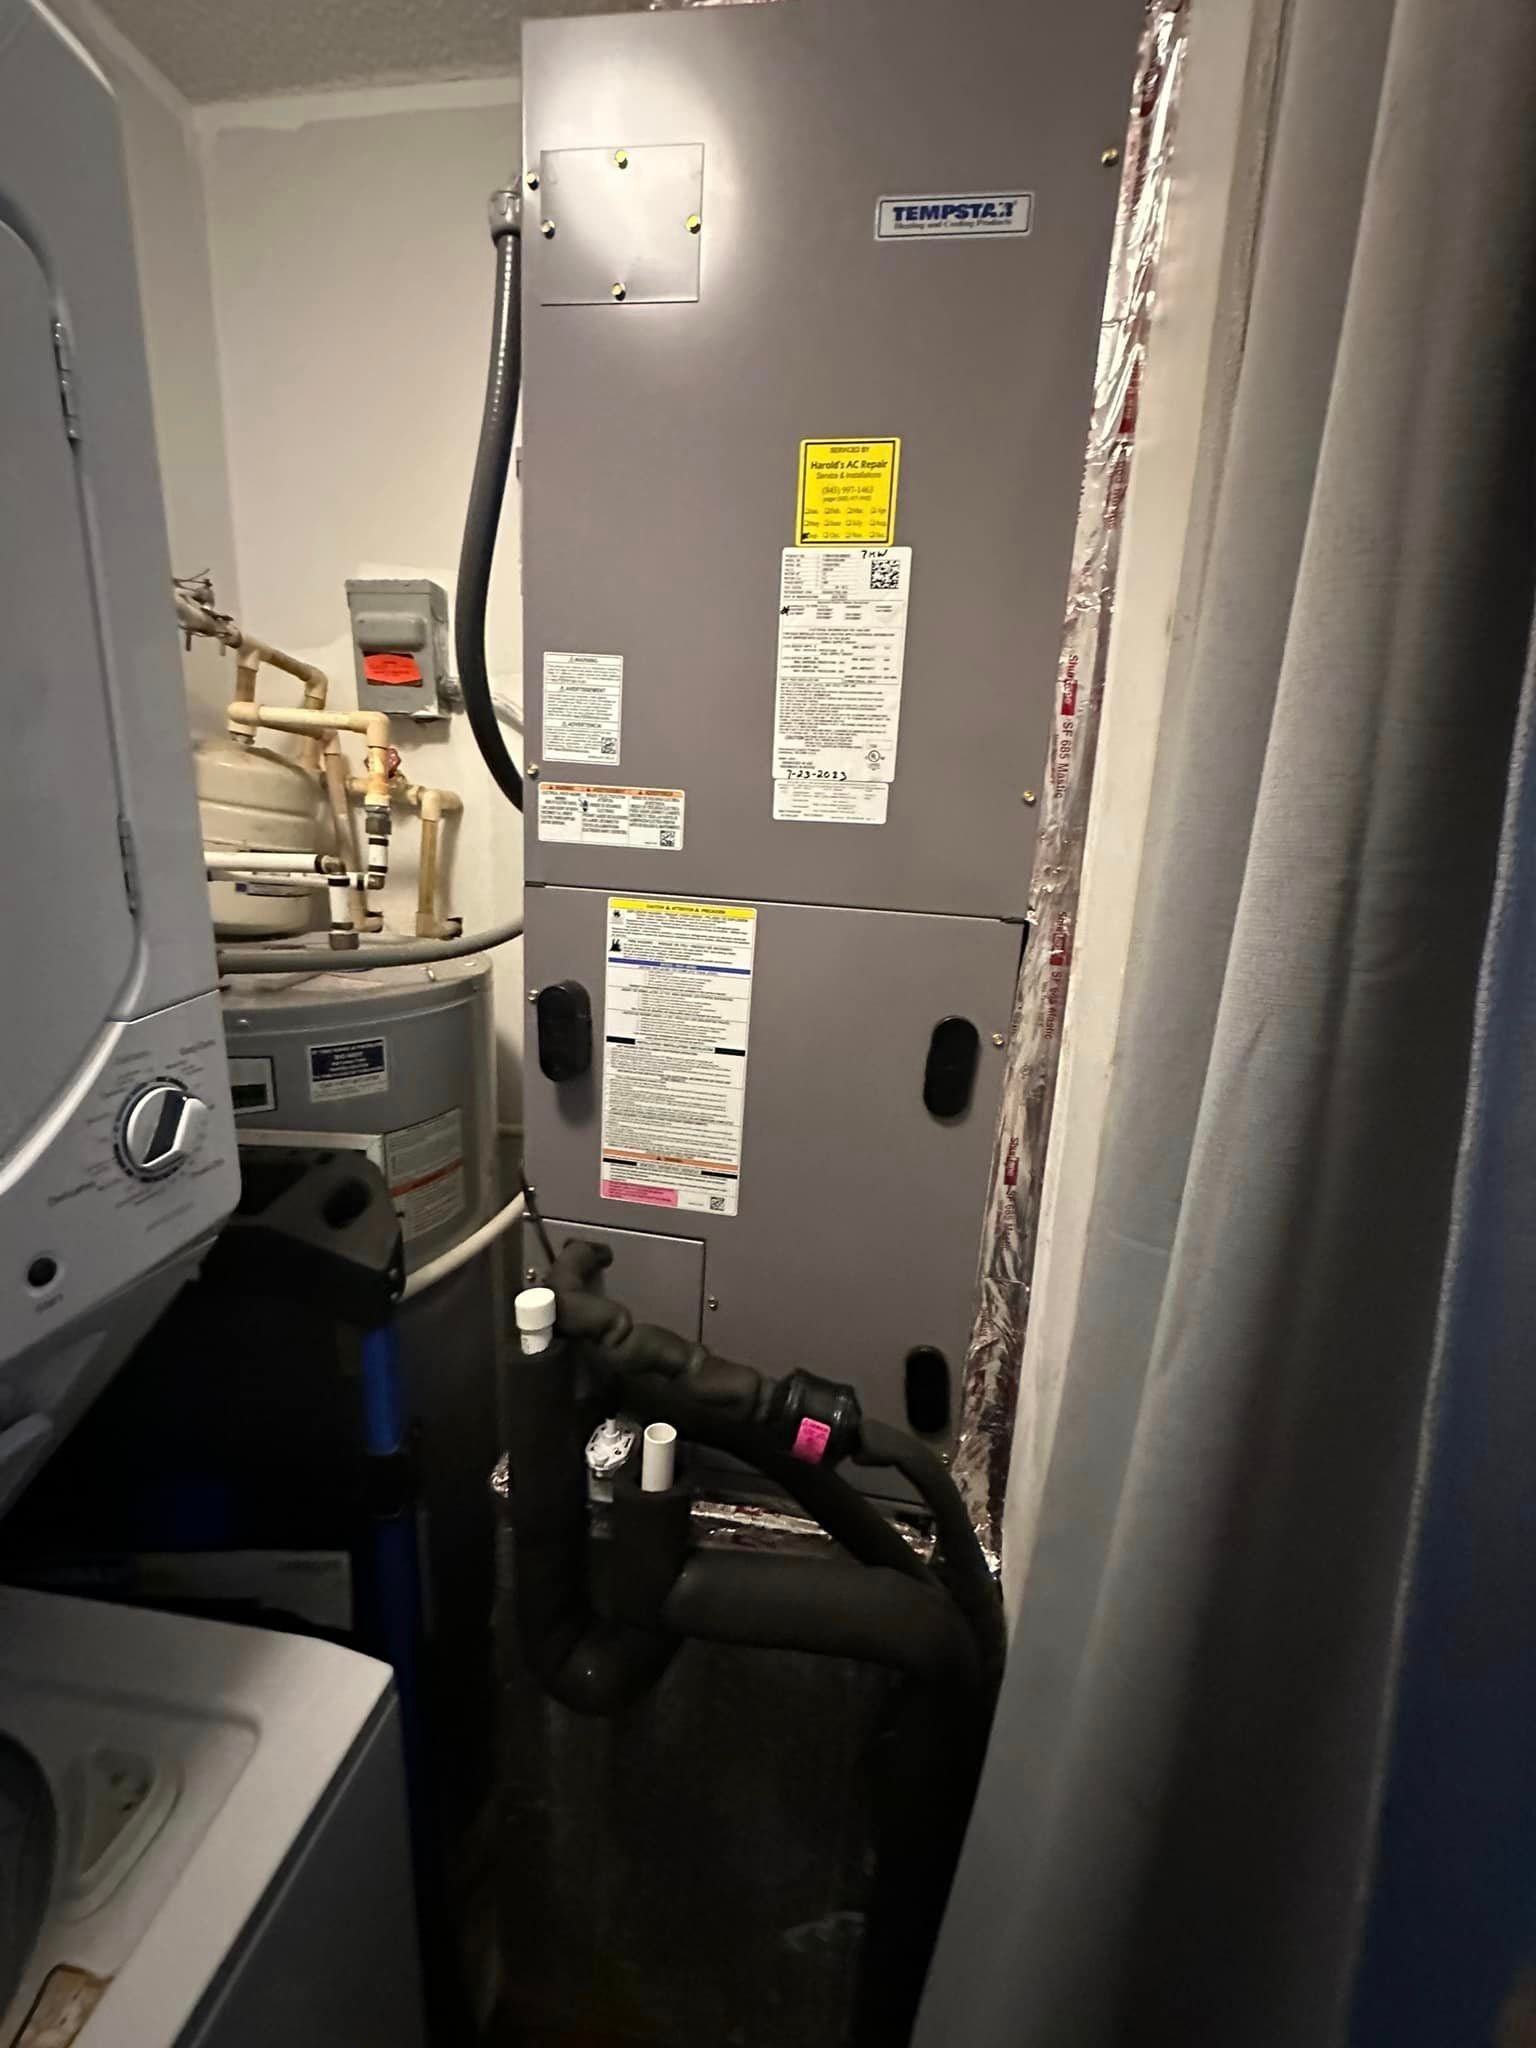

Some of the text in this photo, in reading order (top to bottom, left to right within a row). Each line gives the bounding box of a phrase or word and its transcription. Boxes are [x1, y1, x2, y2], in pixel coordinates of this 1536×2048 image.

[927, 221, 942, 229] and
[944, 220, 975, 229] Cooling
[976, 218, 1012, 227] Products
[811, 459, 889, 471] Harold's AC Repair
[1062, 721, 1075, 736] SF
[1059, 739, 1072, 760] 685
[785, 769, 848, 782] 7-23-2023
[1054, 763, 1070, 799] Mastic
